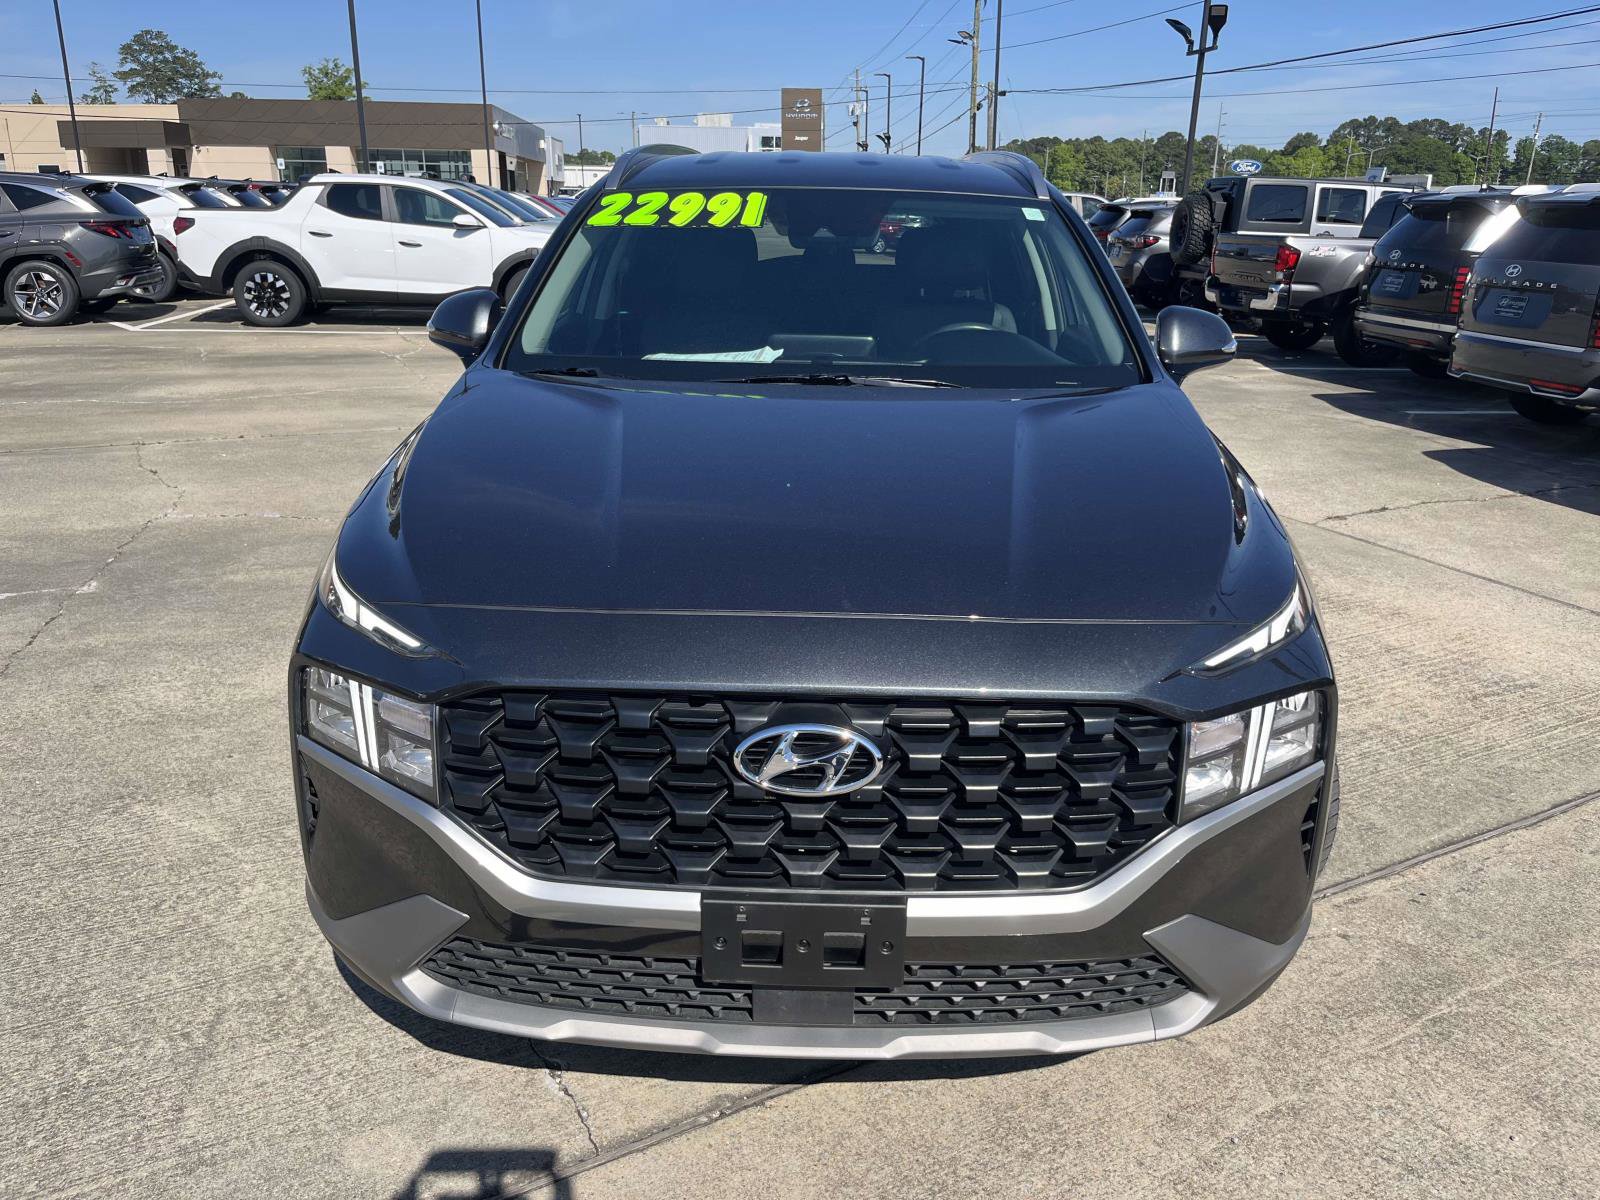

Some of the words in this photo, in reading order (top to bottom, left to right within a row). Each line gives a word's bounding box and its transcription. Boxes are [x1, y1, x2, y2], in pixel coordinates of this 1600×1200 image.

[785, 112, 818, 120] HYUNDAI
[1236, 162, 1257, 172] Ford
[586, 191, 767, 227] 22991
